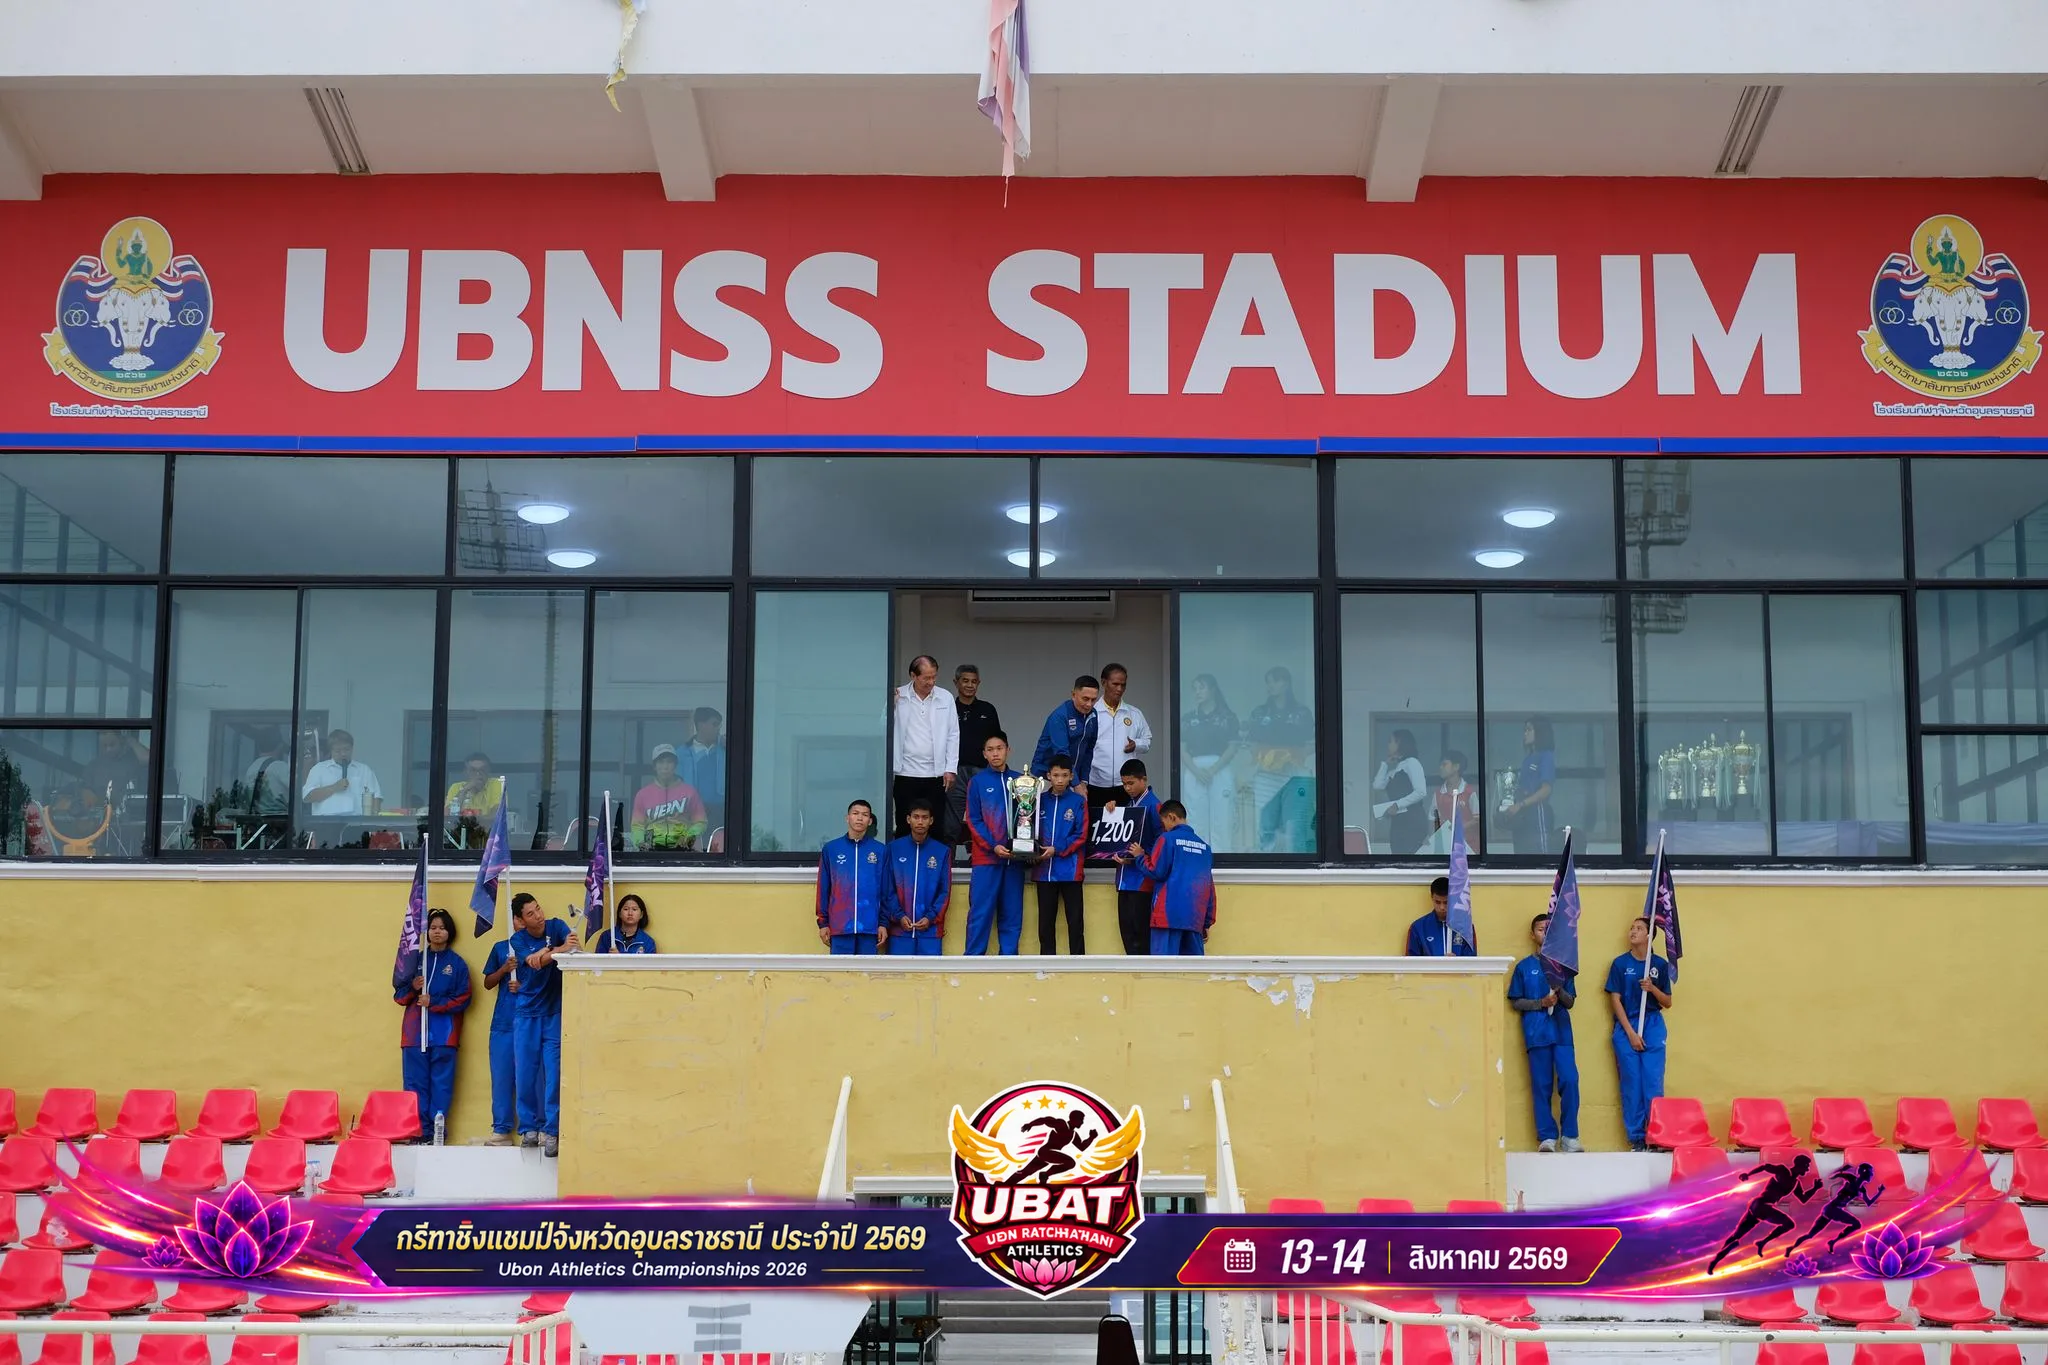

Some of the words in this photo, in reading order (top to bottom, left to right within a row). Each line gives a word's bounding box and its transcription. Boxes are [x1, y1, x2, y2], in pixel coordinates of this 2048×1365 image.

[284, 248, 884, 397] UBNSS
[987, 250, 1802, 397] STADIUM
[1091, 818, 1134, 846] 1,200
